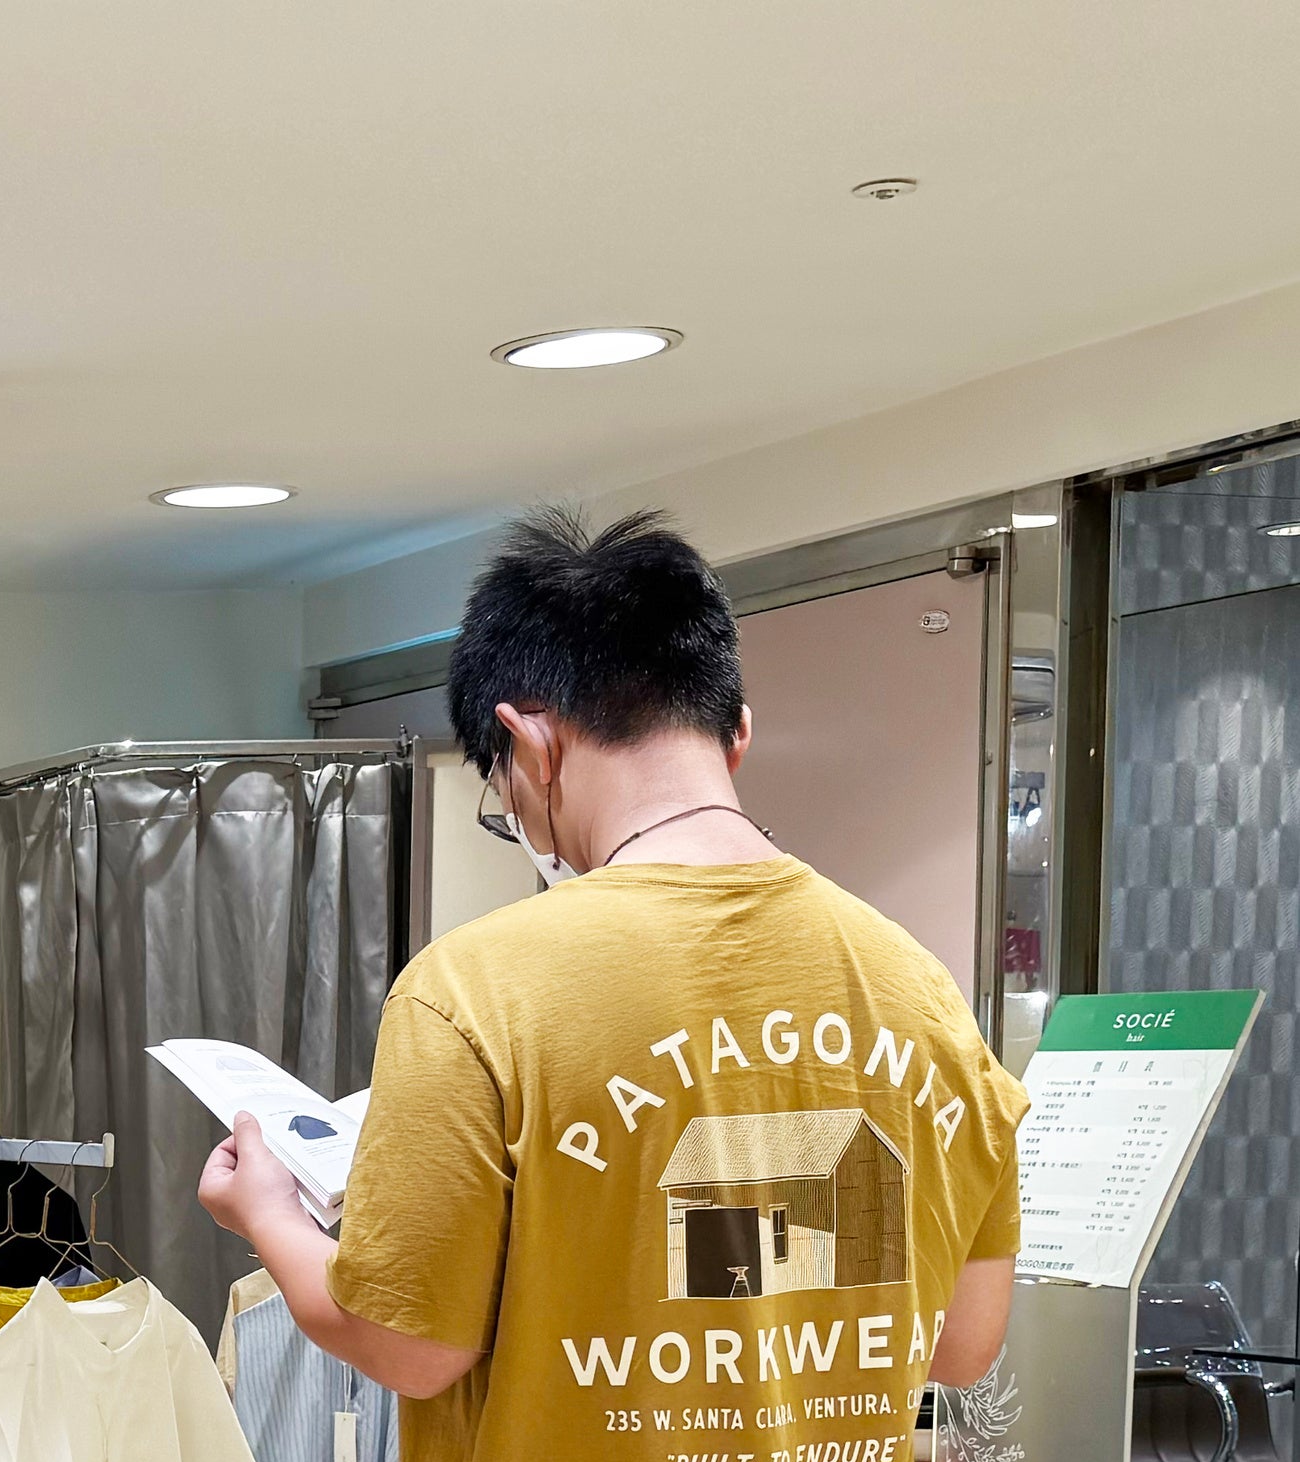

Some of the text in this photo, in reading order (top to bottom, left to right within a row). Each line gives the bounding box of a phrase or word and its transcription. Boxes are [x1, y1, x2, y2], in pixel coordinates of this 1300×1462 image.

[1113, 1009, 1175, 1029] SOCIÉ
[557, 1009, 967, 1172] PATAGONIA
[605, 1409, 642, 1432] 235
[653, 1409, 676, 1431] W.
[682, 1407, 744, 1431] SANTA
